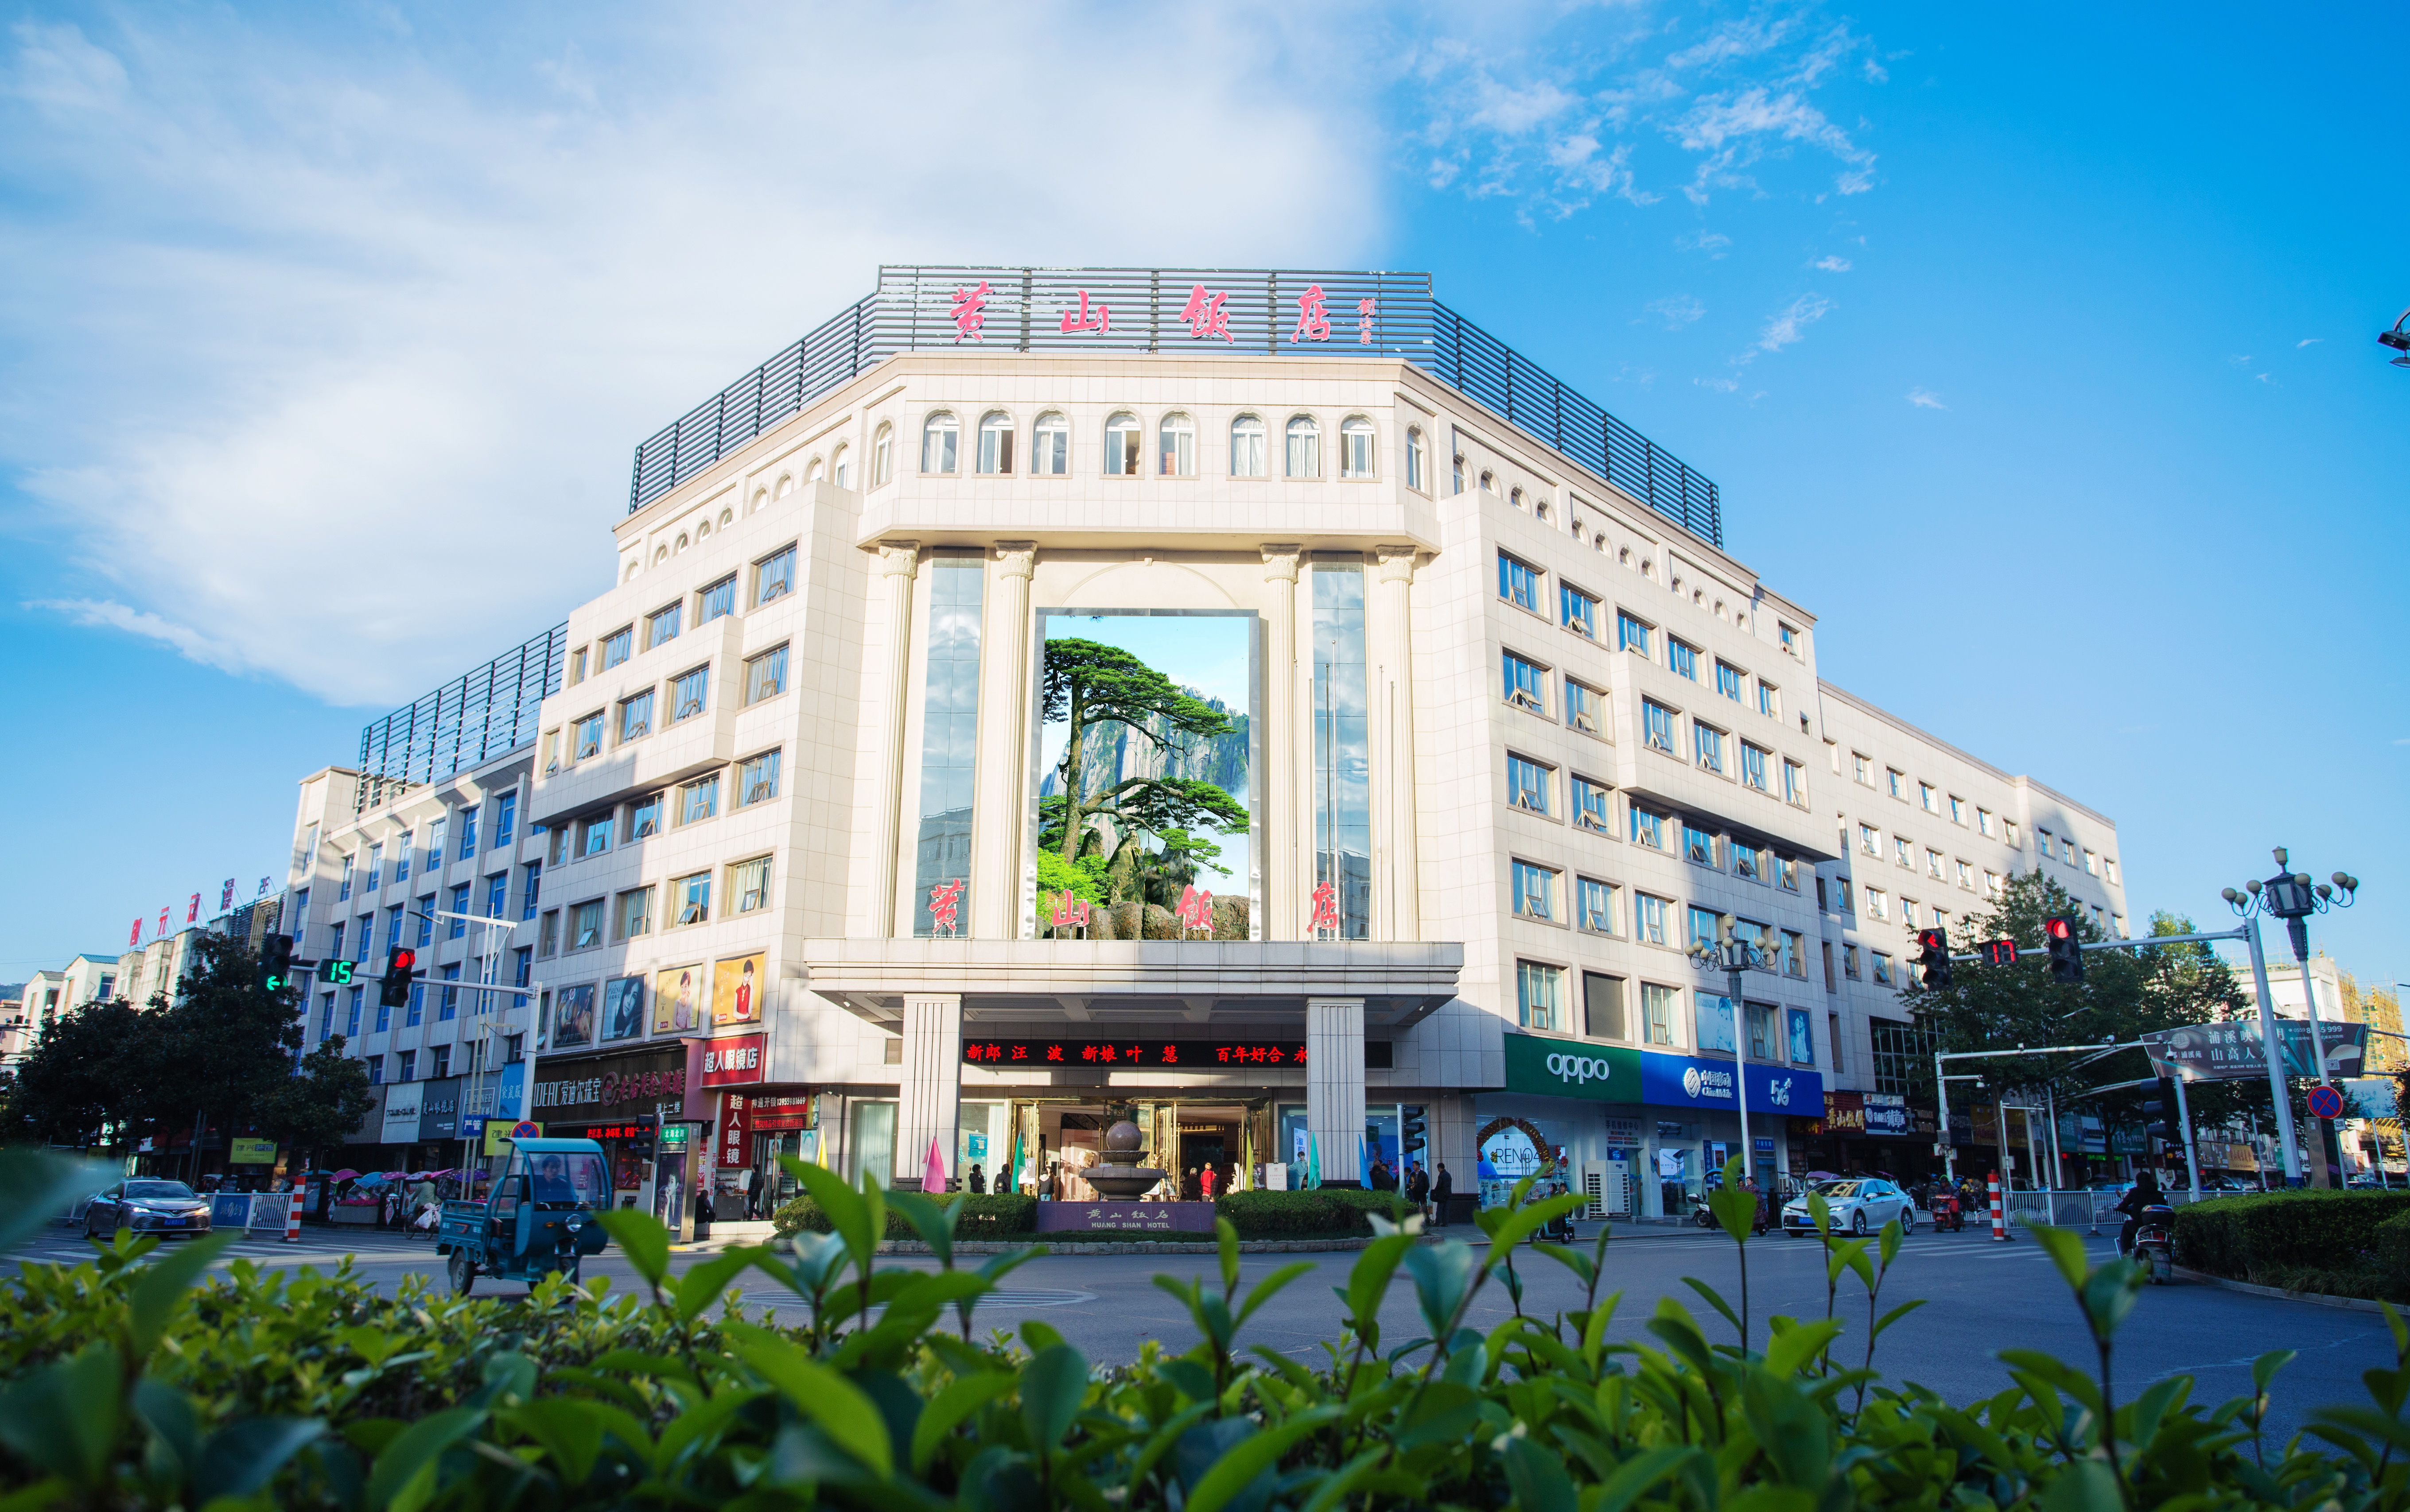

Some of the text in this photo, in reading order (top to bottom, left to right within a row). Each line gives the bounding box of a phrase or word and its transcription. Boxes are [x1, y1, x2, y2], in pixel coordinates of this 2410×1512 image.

[1993, 942, 2015, 963] 17
[330, 961, 351, 983] 15
[704, 1047, 758, 1073] 超人眼镜店
[1216, 1046, 1284, 1063] 百年好合
[1701, 1070, 1731, 1087] 中国移动
[533, 1082, 559, 1107] IDEAL
[560, 1078, 601, 1105] 爱迪尔珠宝
[423, 1099, 454, 1115] 黄山眼镜店
[657, 1101, 680, 1114] 请上二楼
[777, 1097, 806, 1106] 13955981669
[464, 1120, 483, 1130] 严管
[665, 1129, 684, 1138] 北海北路
[726, 1094, 744, 1163] 超人眼镜
